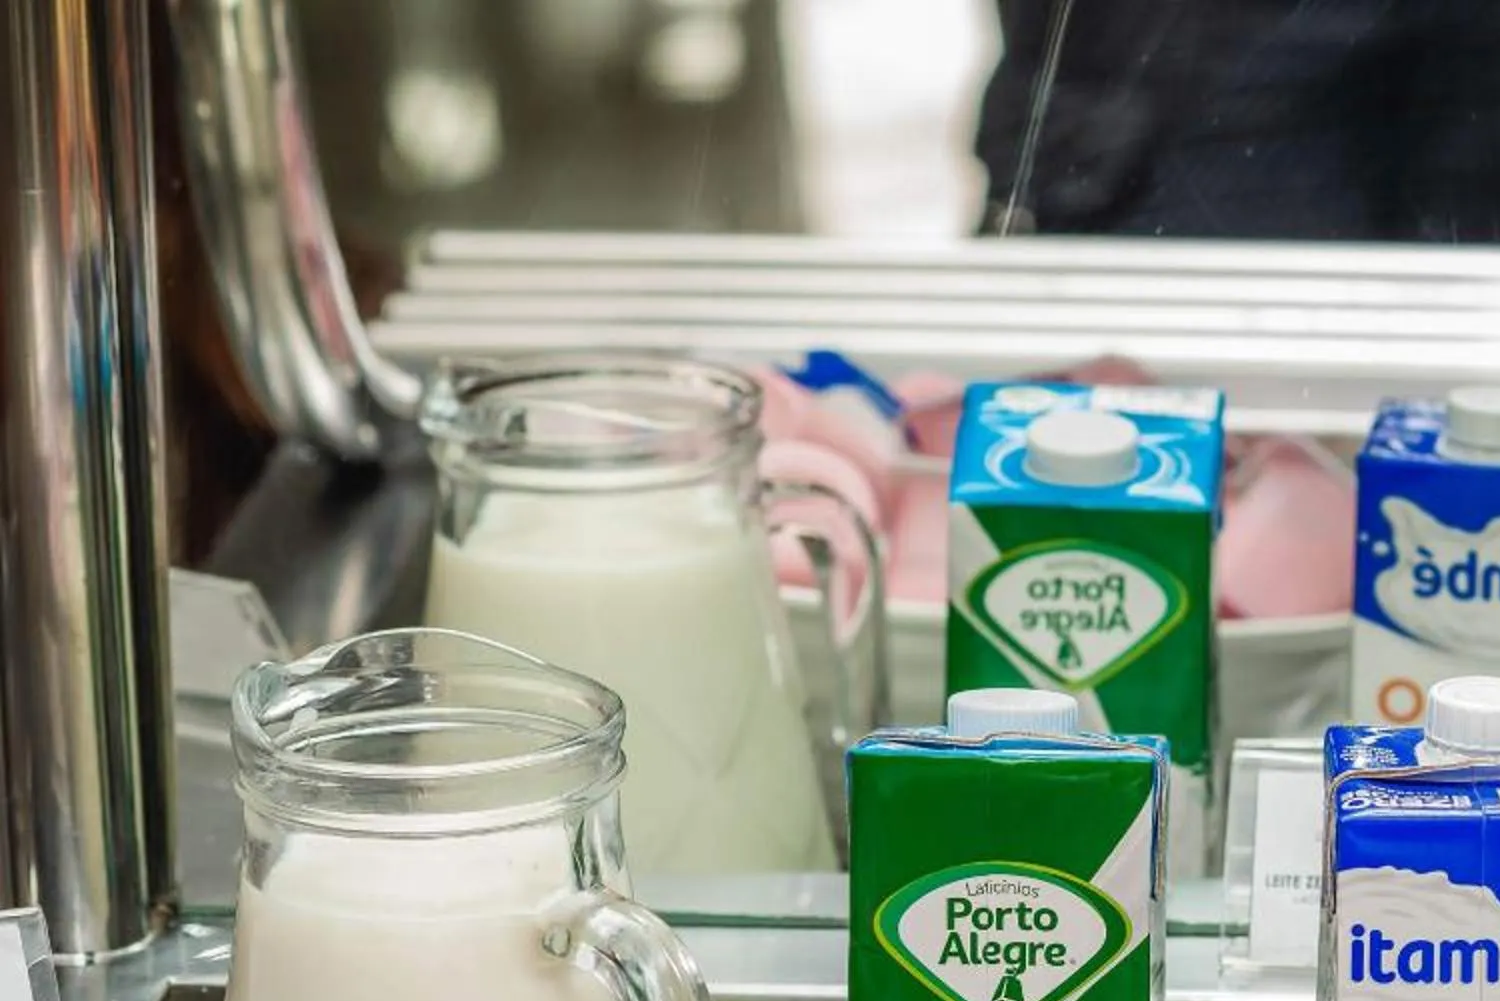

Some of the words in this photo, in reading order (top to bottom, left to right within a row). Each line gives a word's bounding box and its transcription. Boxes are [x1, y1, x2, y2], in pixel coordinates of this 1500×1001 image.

[1265, 874, 1300, 890] LEITE
[945, 897, 1059, 932] Porto
[938, 931, 1067, 975] Alegre
